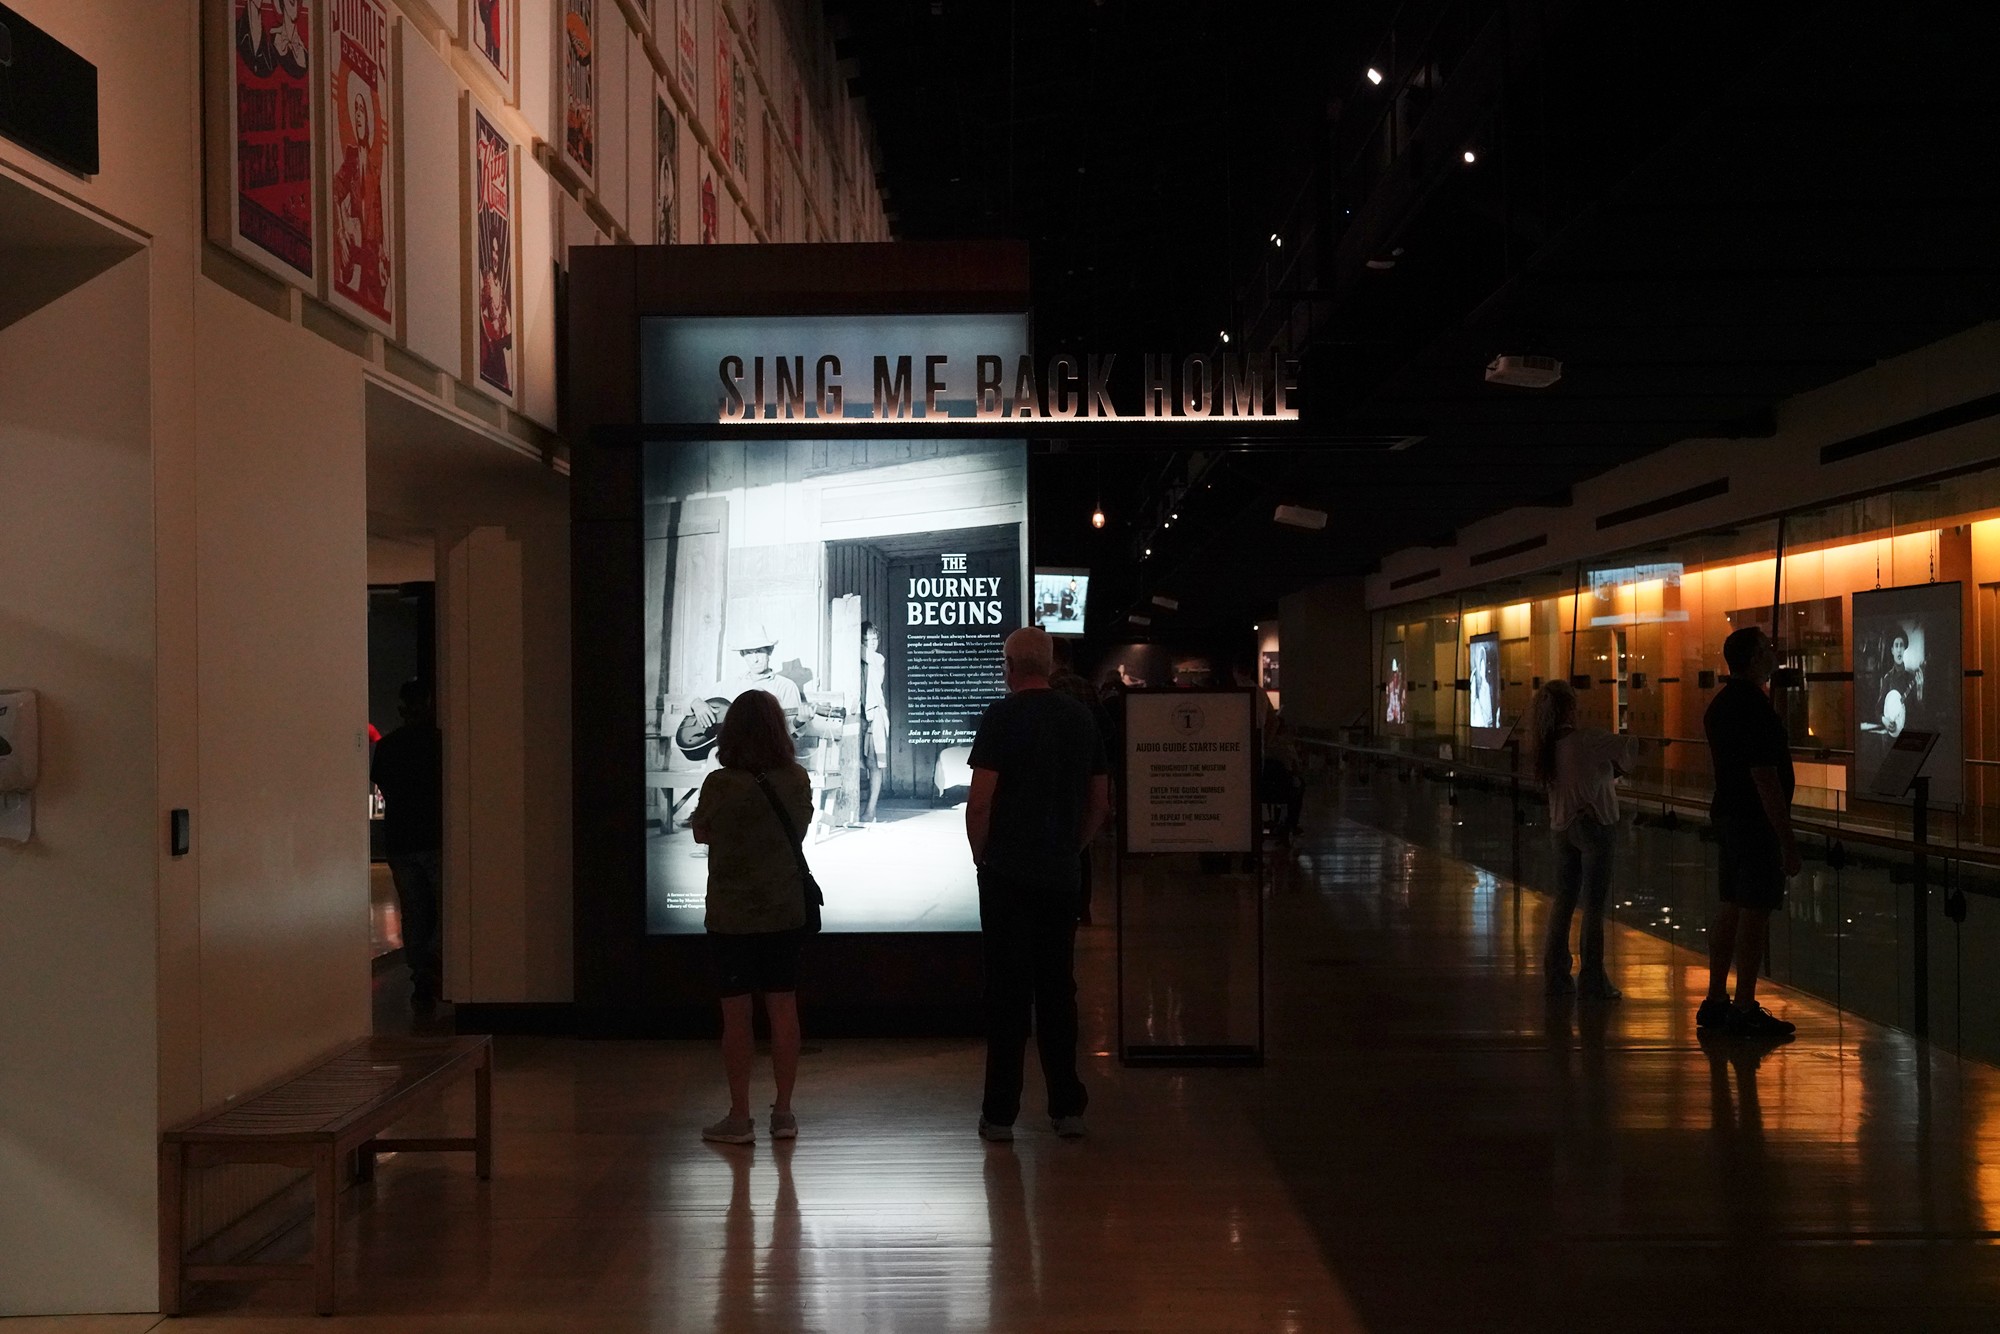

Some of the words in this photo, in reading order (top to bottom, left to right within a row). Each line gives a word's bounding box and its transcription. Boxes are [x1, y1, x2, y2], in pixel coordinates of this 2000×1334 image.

[477, 138, 509, 211] Kitty
[718, 354, 844, 421] SING
[873, 354, 951, 421] ME
[975, 353, 1117, 421] BACK
[1144, 350, 1301, 420] HOME
[942, 557, 967, 570] THE
[907, 578, 1001, 598] JOURNEY
[906, 601, 1002, 626] BEGINS
[1184, 714, 1192, 728] 1
[1136, 742, 1160, 752] AUDIO
[1163, 742, 1187, 752] GUIDE
[1189, 742, 1217, 752] STARTS
[1219, 742, 1240, 752] HERE
